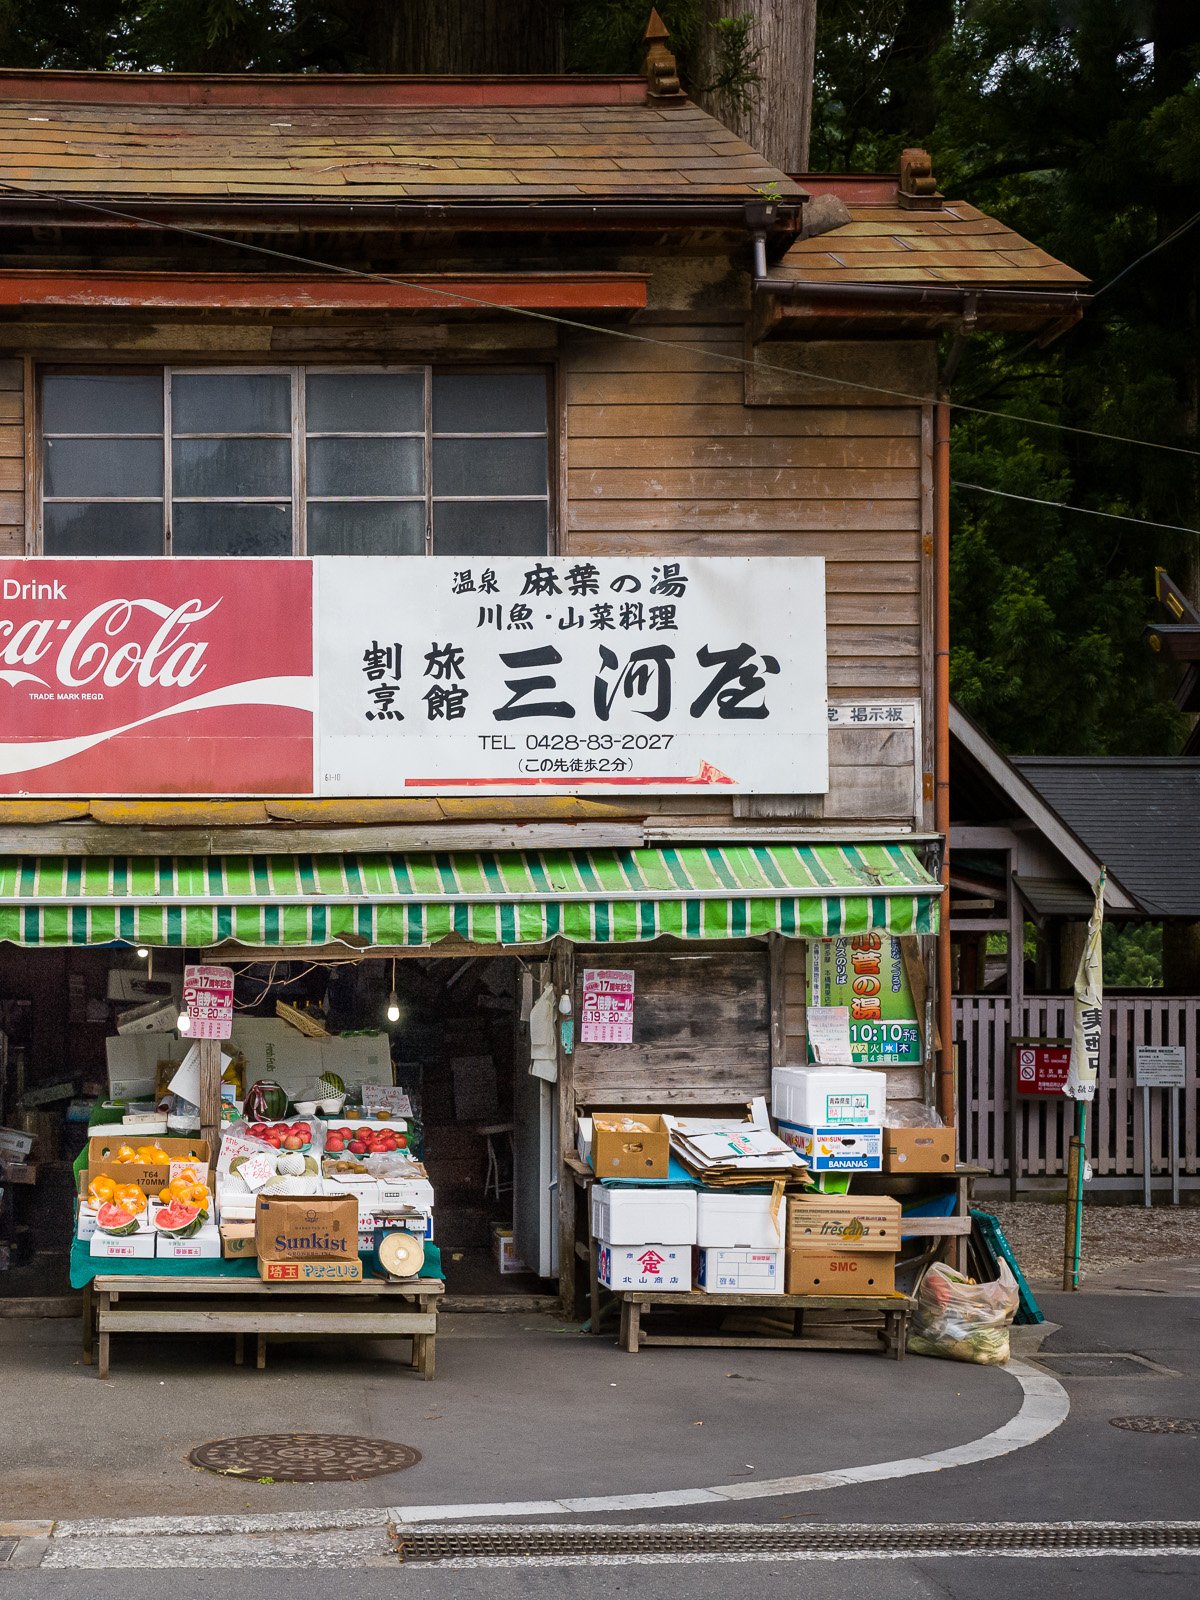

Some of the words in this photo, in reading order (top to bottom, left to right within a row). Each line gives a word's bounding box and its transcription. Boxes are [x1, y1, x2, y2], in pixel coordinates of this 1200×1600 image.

[452, 568, 500, 594] 温泉
[520, 562, 689, 597] 麻葉の湯
[3, 579, 67, 600] Drink
[477, 602, 678, 631] 川魚・山菜料理
[362, 641, 404, 721] 割烹
[422, 641, 466, 720] 旅館
[492, 643, 781, 722] 三河屋
[849, 706, 904, 722] 掲示板
[478, 735, 516, 750] TEL
[526, 734, 675, 750] 0428-83-2027
[828, 1160, 869, 1168] BANANAS
[136, 1178, 166, 1186] 170MM
[274, 1232, 348, 1252] Sunkist
[269, 1265, 298, 1279] 埼玉
[303, 1264, 360, 1278] やまといも
[830, 1262, 857, 1272] SMC
[623, 1276, 679, 1284] 北山商店
